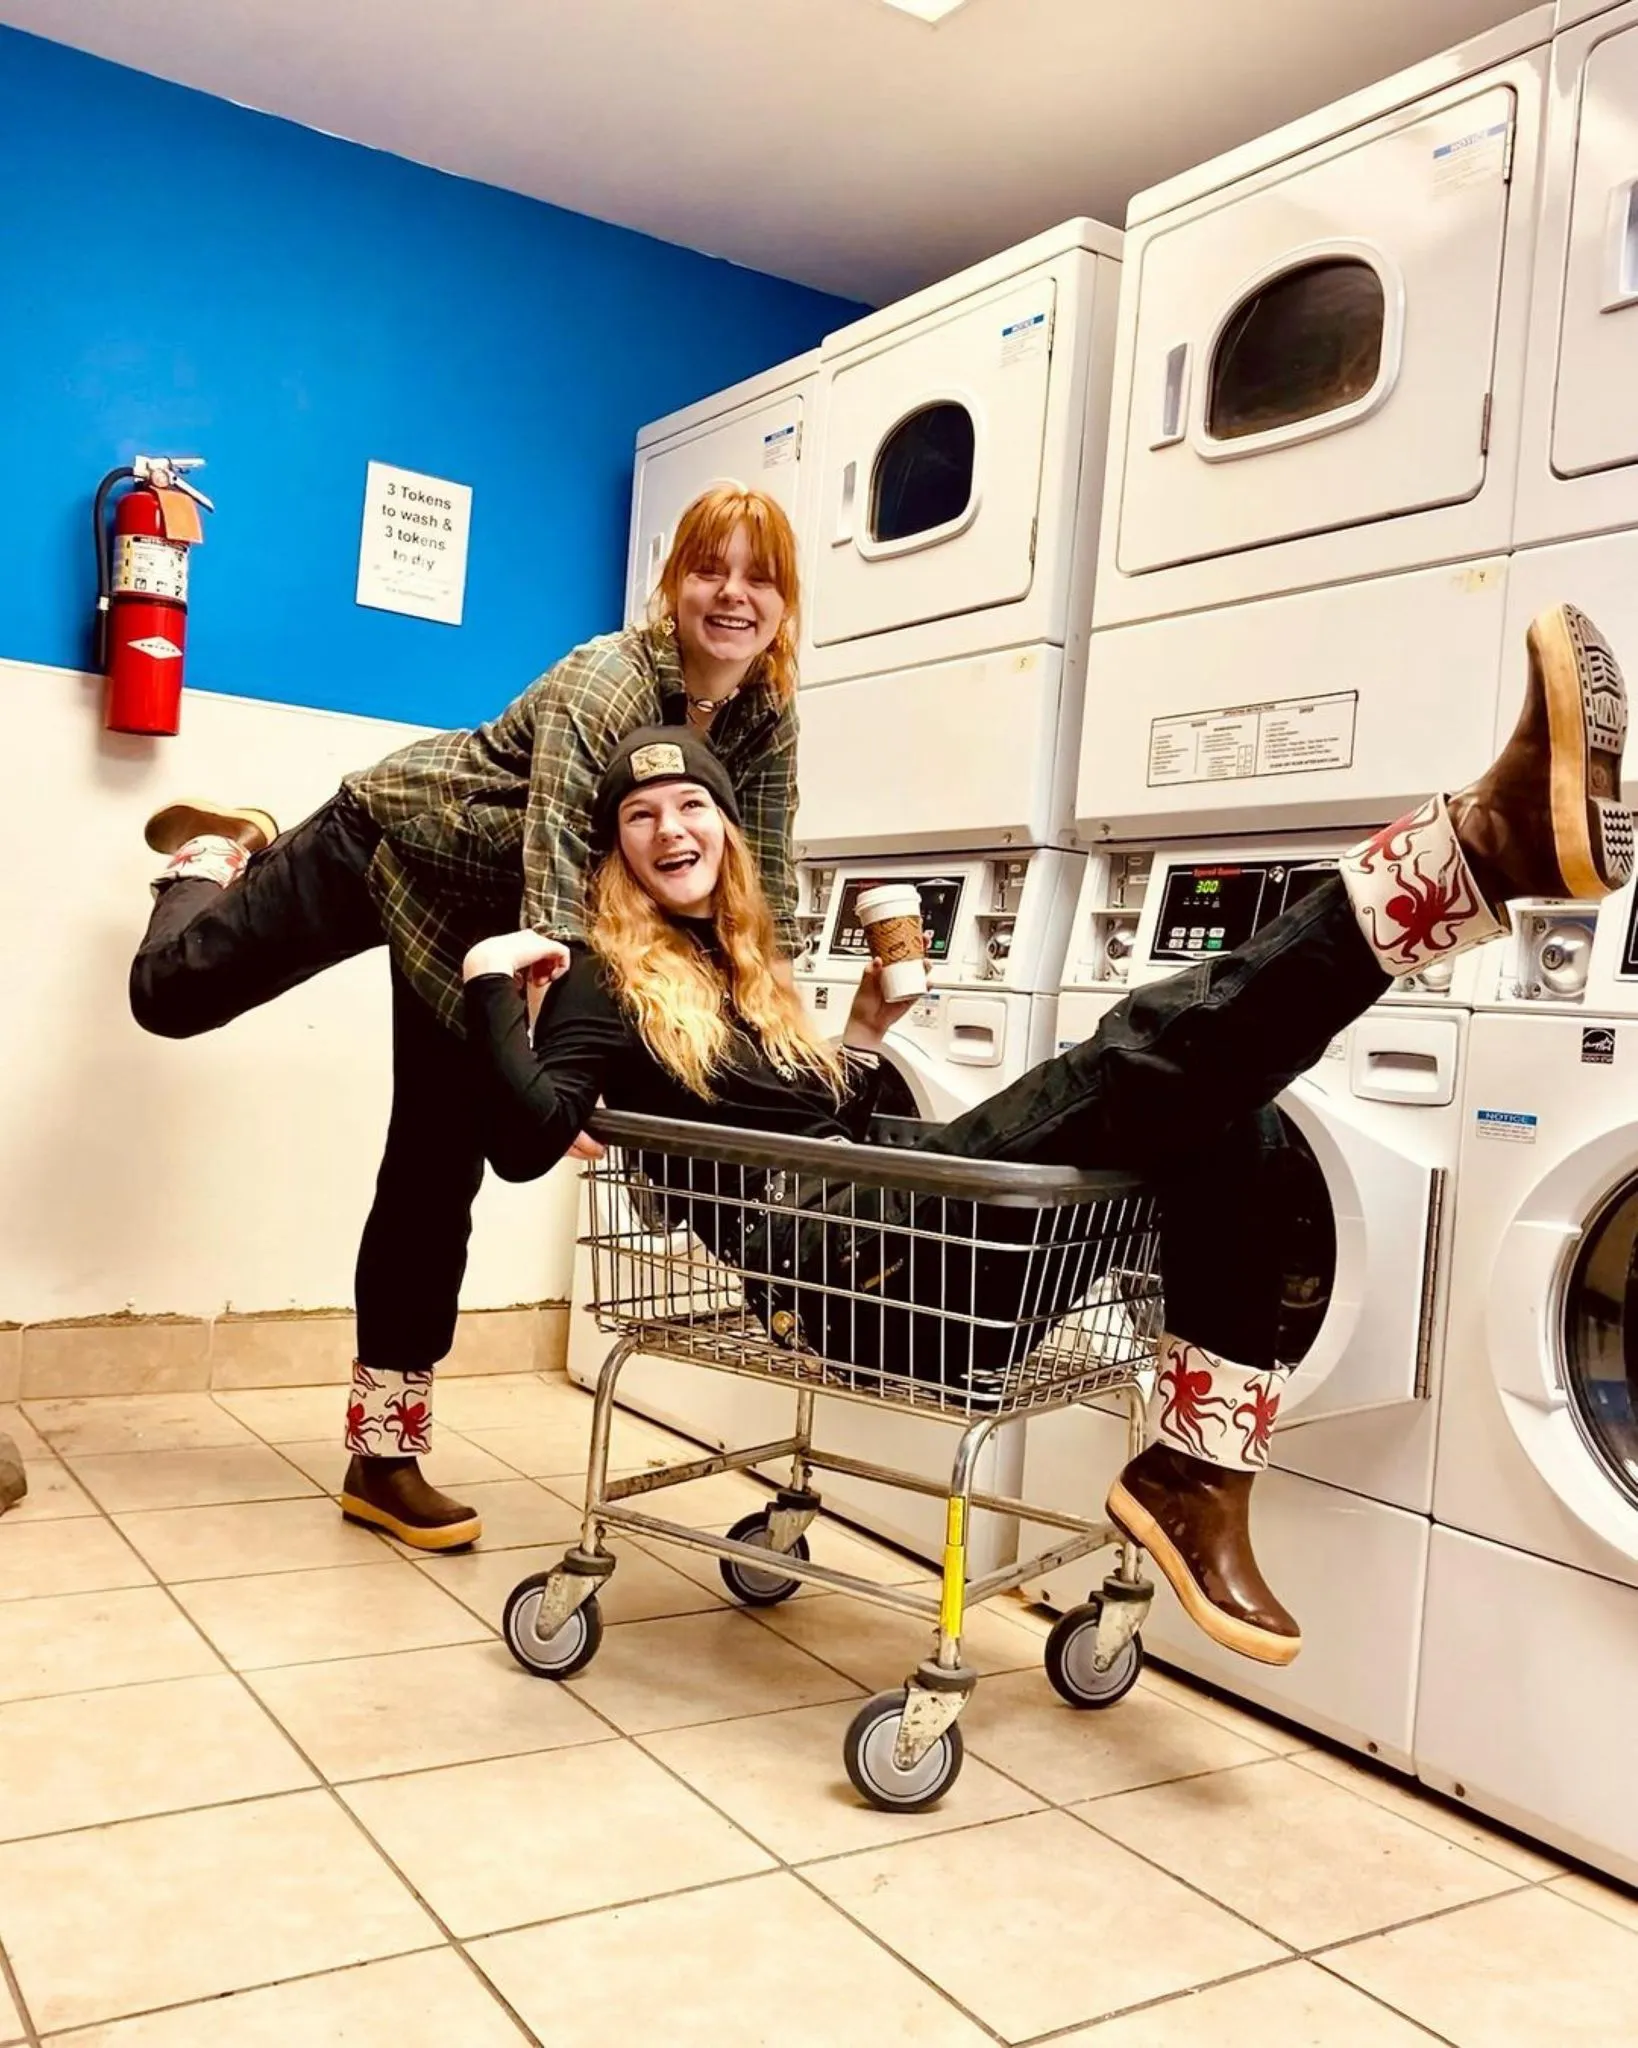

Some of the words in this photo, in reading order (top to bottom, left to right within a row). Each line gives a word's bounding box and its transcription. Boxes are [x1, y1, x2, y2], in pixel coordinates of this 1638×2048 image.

[387, 483, 396, 496] 3
[401, 485, 452, 510] Tokens
[382, 504, 396, 517] to
[401, 510, 439, 528] wash
[442, 518, 452, 532] &
[385, 525, 393, 538] 3
[398, 529, 446, 551] tokens
[393, 549, 408, 562] to
[1195, 880, 1219, 894] 300
